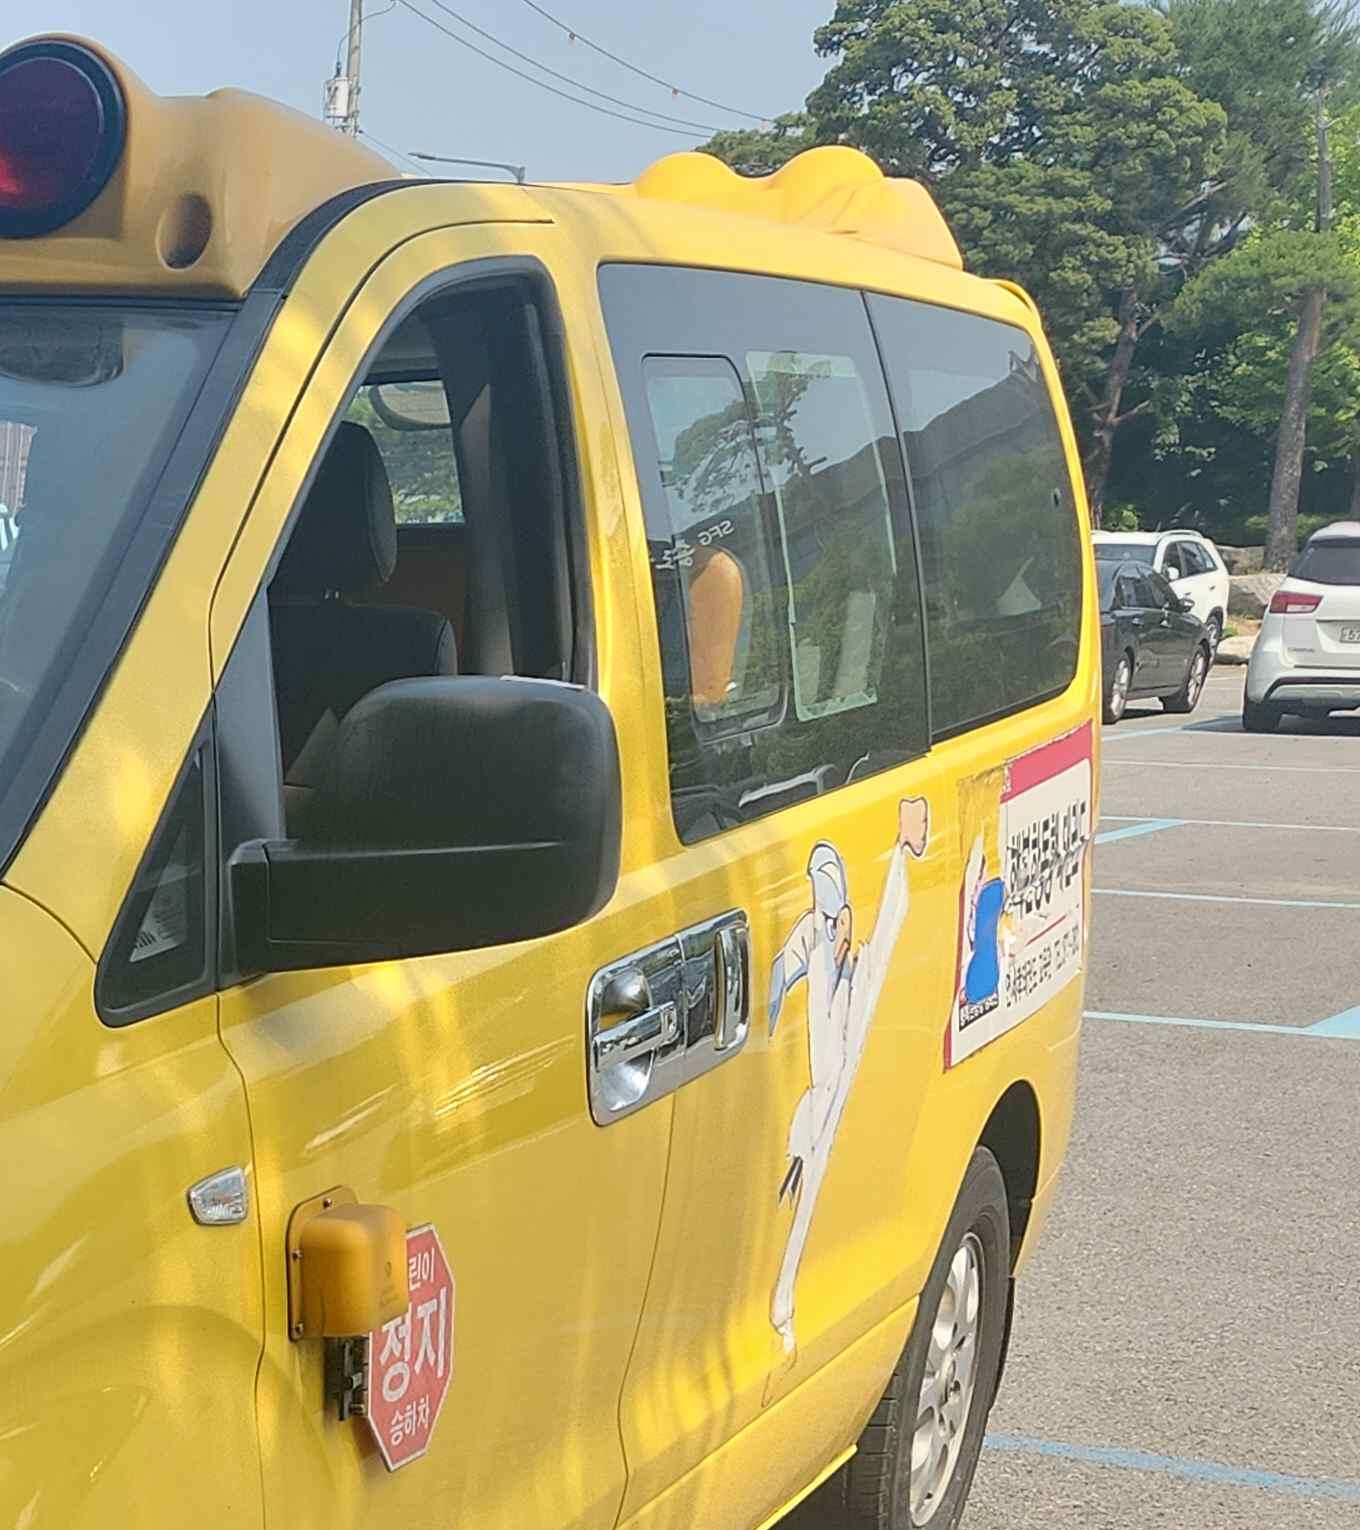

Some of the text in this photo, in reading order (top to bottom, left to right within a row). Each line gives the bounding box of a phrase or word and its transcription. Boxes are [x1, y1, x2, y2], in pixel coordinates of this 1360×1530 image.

[407, 1246, 435, 1292] 린이
[379, 1286, 448, 1403] 정지
[388, 1393, 431, 1447] 승하차
